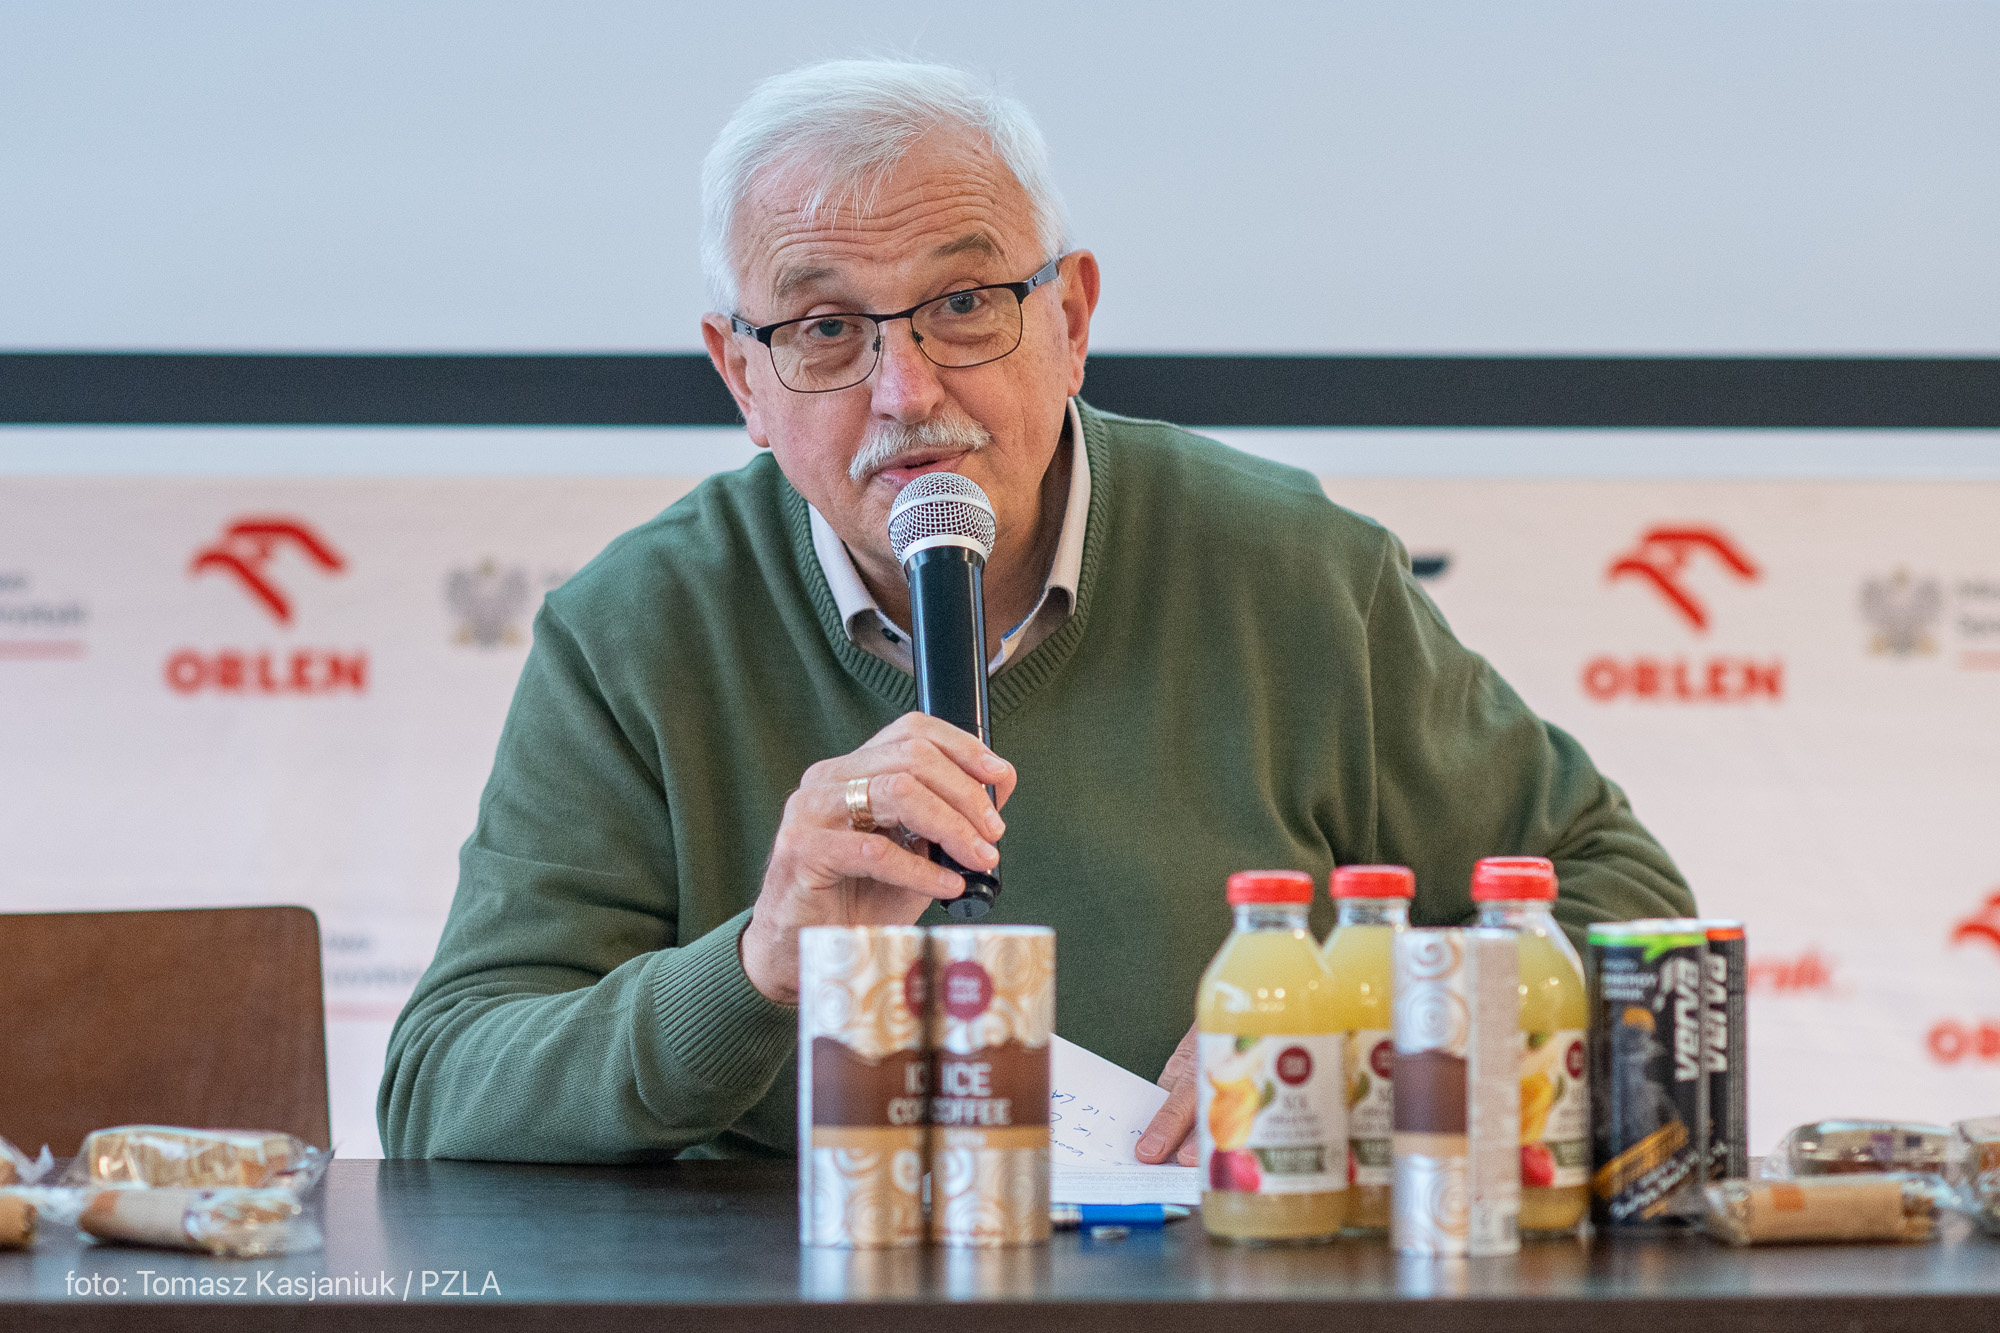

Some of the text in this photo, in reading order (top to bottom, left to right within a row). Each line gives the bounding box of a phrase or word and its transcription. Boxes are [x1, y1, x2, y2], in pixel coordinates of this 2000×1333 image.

[164, 649, 370, 694] ORLEN
[1582, 656, 1784, 702] ORLEN
[1674, 957, 1700, 1083] verva
[942, 1062, 992, 1096] ICE
